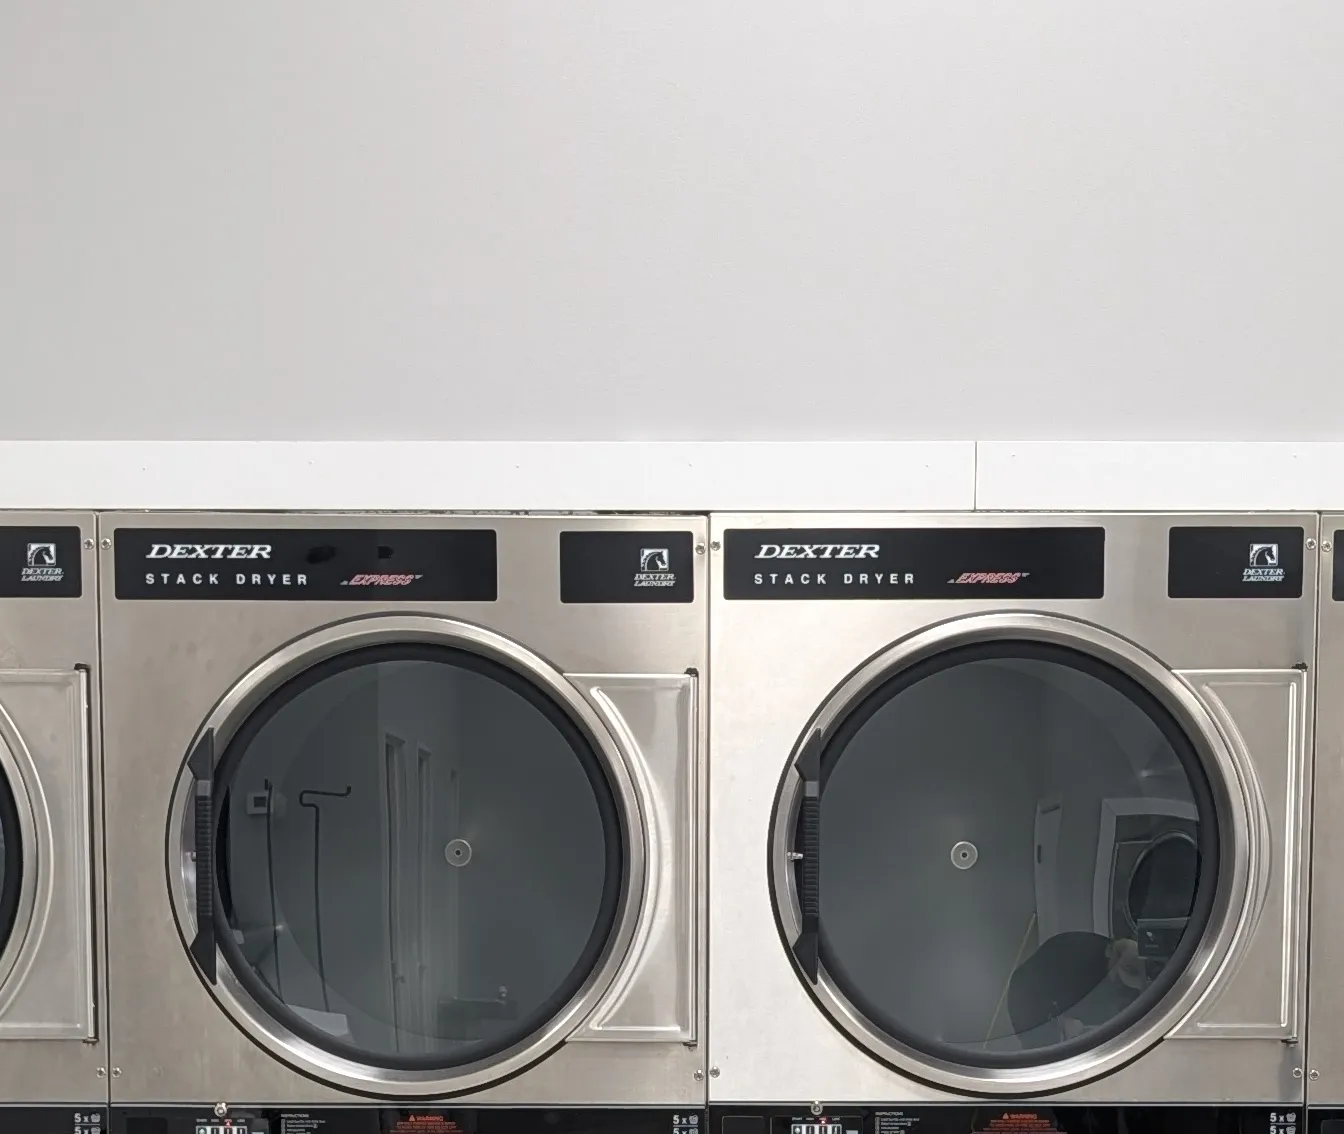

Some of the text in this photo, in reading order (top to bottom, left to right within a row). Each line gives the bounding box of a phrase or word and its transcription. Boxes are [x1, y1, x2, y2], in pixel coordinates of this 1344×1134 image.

[145, 544, 272, 559] DEXTER
[754, 544, 880, 559] DEXTER
[21, 567, 62, 575] DEXTER
[634, 572, 674, 580] DEXTER
[1243, 567, 1284, 576] DEXTER
[145, 573, 307, 586] STACK DRYER
[348, 574, 416, 586] EXPRESS
[754, 573, 914, 585] STACK DRYER
[954, 572, 1020, 584] EXPRESS
[74, 1113, 81, 1123] 5
[673, 1115, 680, 1125] 5
[1270, 1113, 1277, 1122] 5
